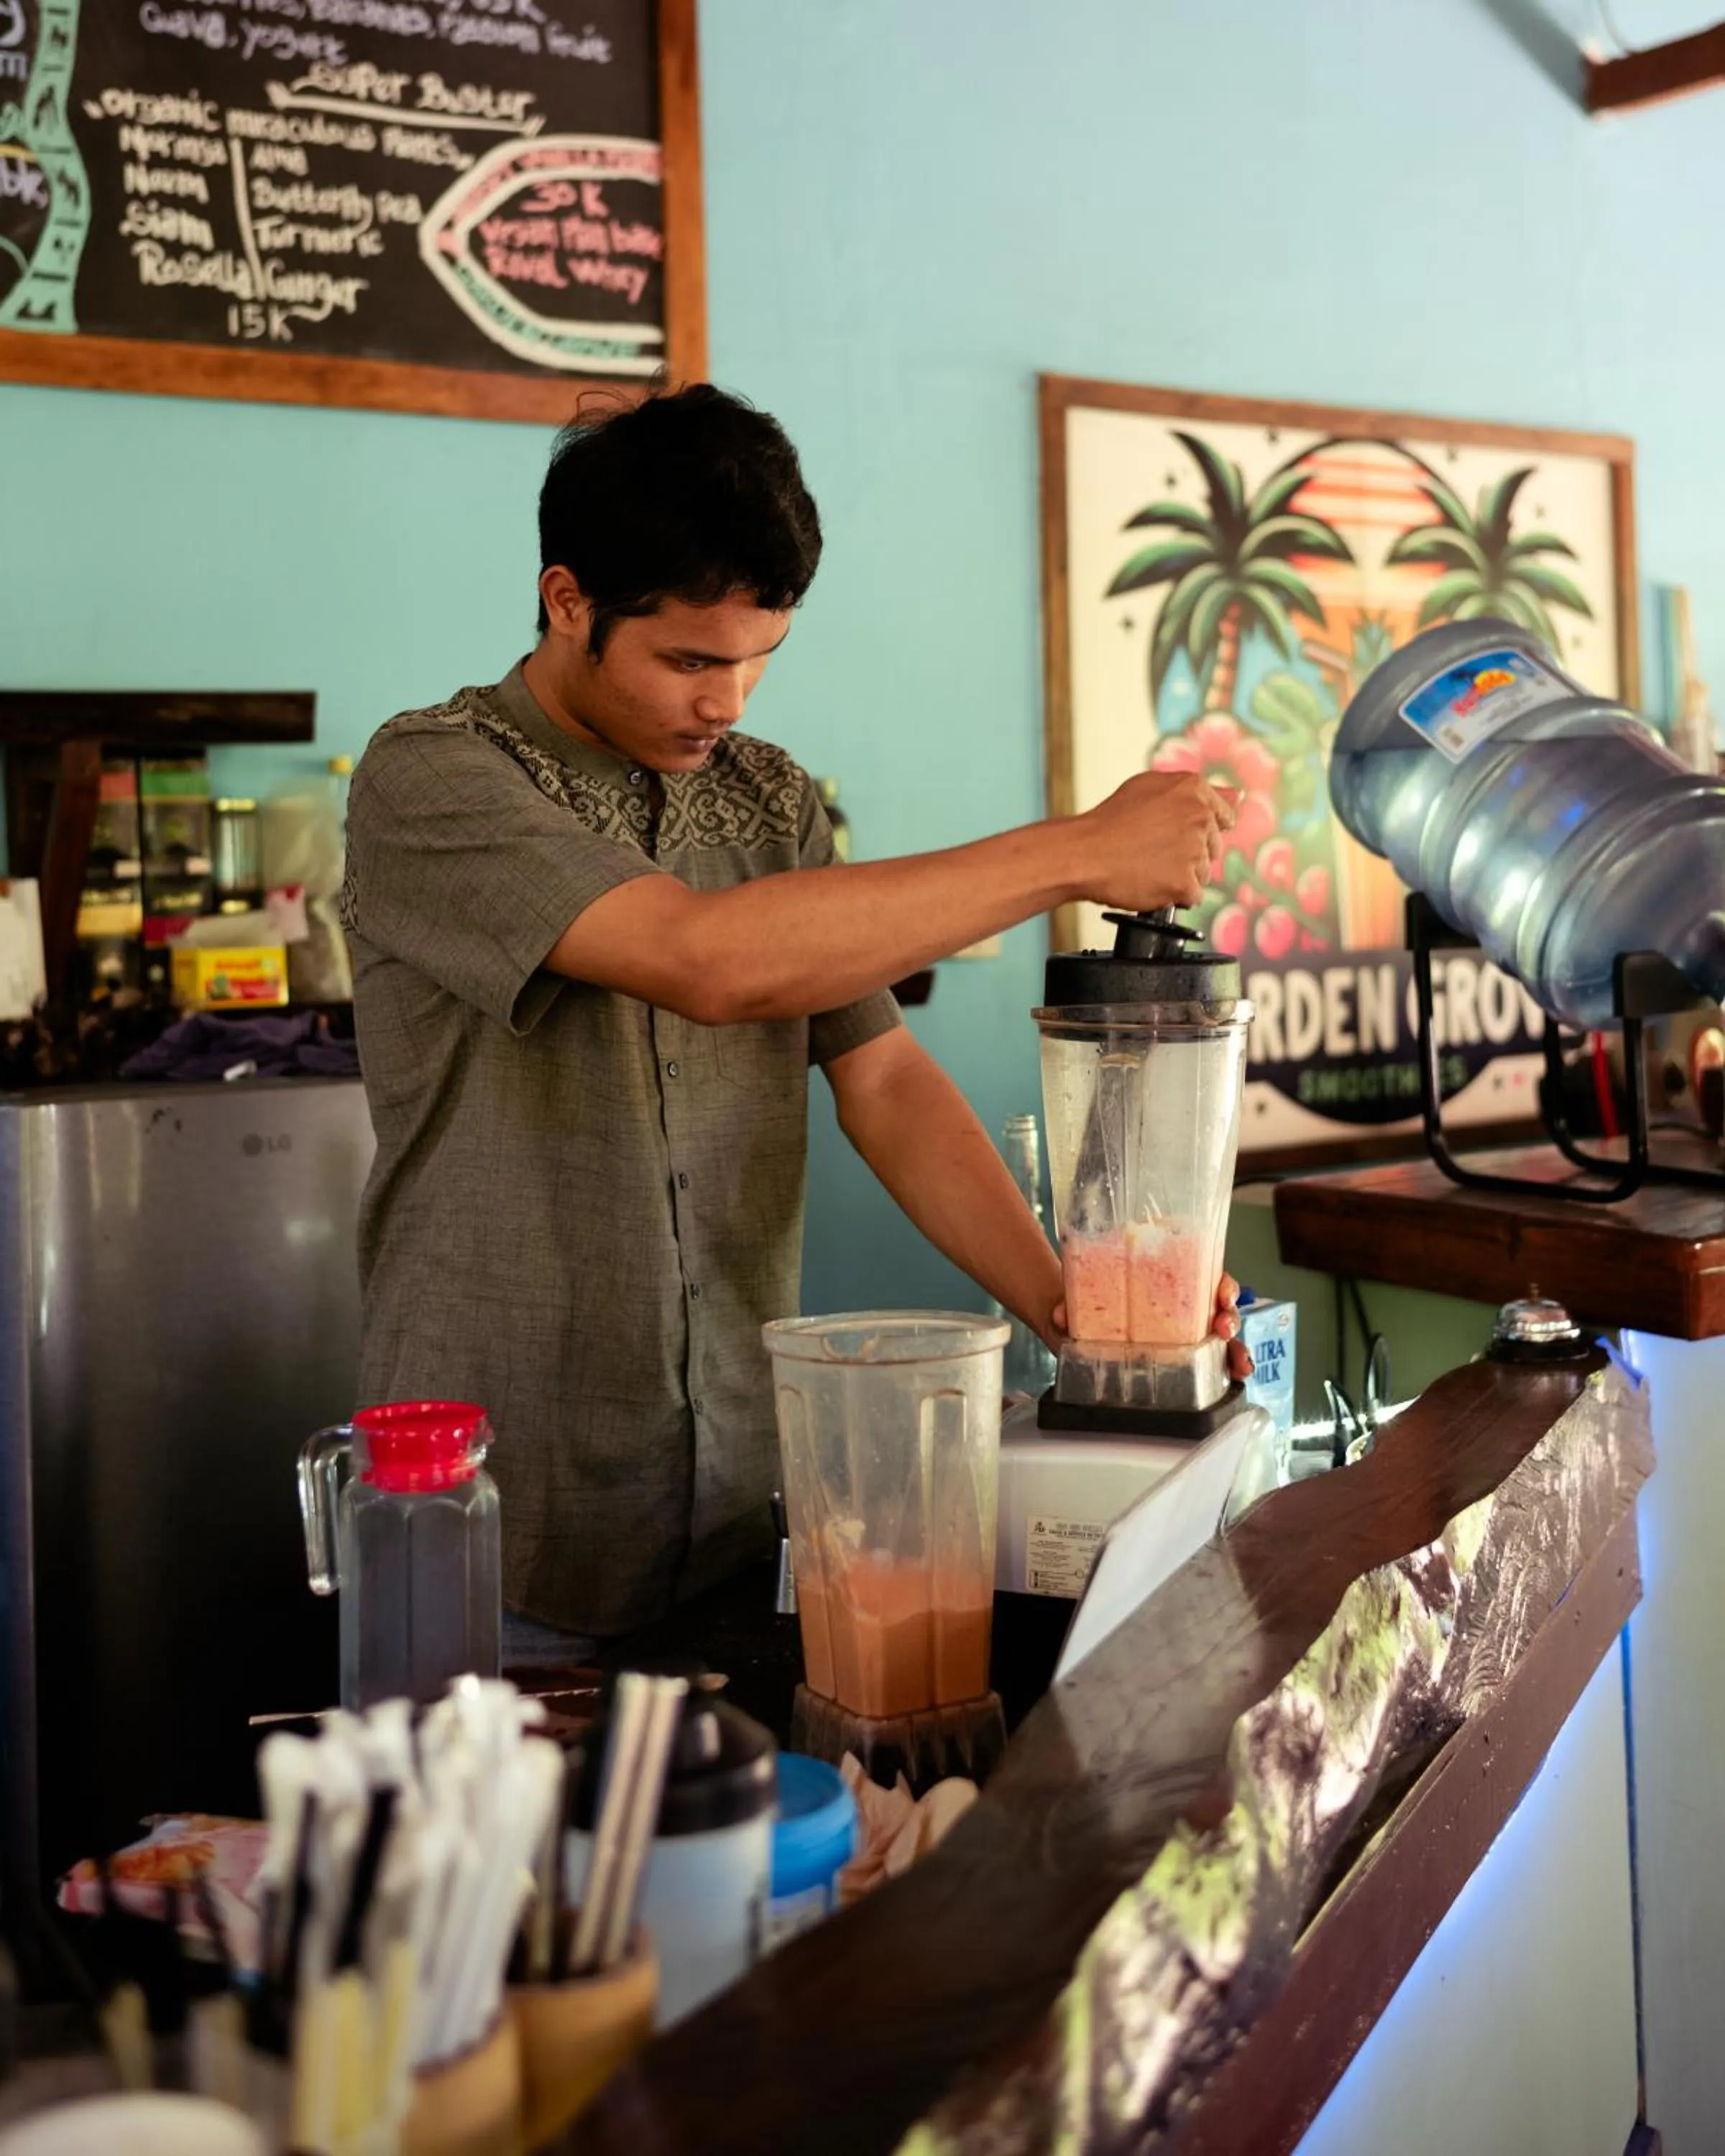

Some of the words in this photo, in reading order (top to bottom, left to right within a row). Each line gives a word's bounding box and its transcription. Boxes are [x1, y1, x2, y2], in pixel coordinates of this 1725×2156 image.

[1247, 964, 1398, 1066] RDEN
[267, 1133, 293, 1154] LG
[1254, 1337, 1286, 1364] LTRA
